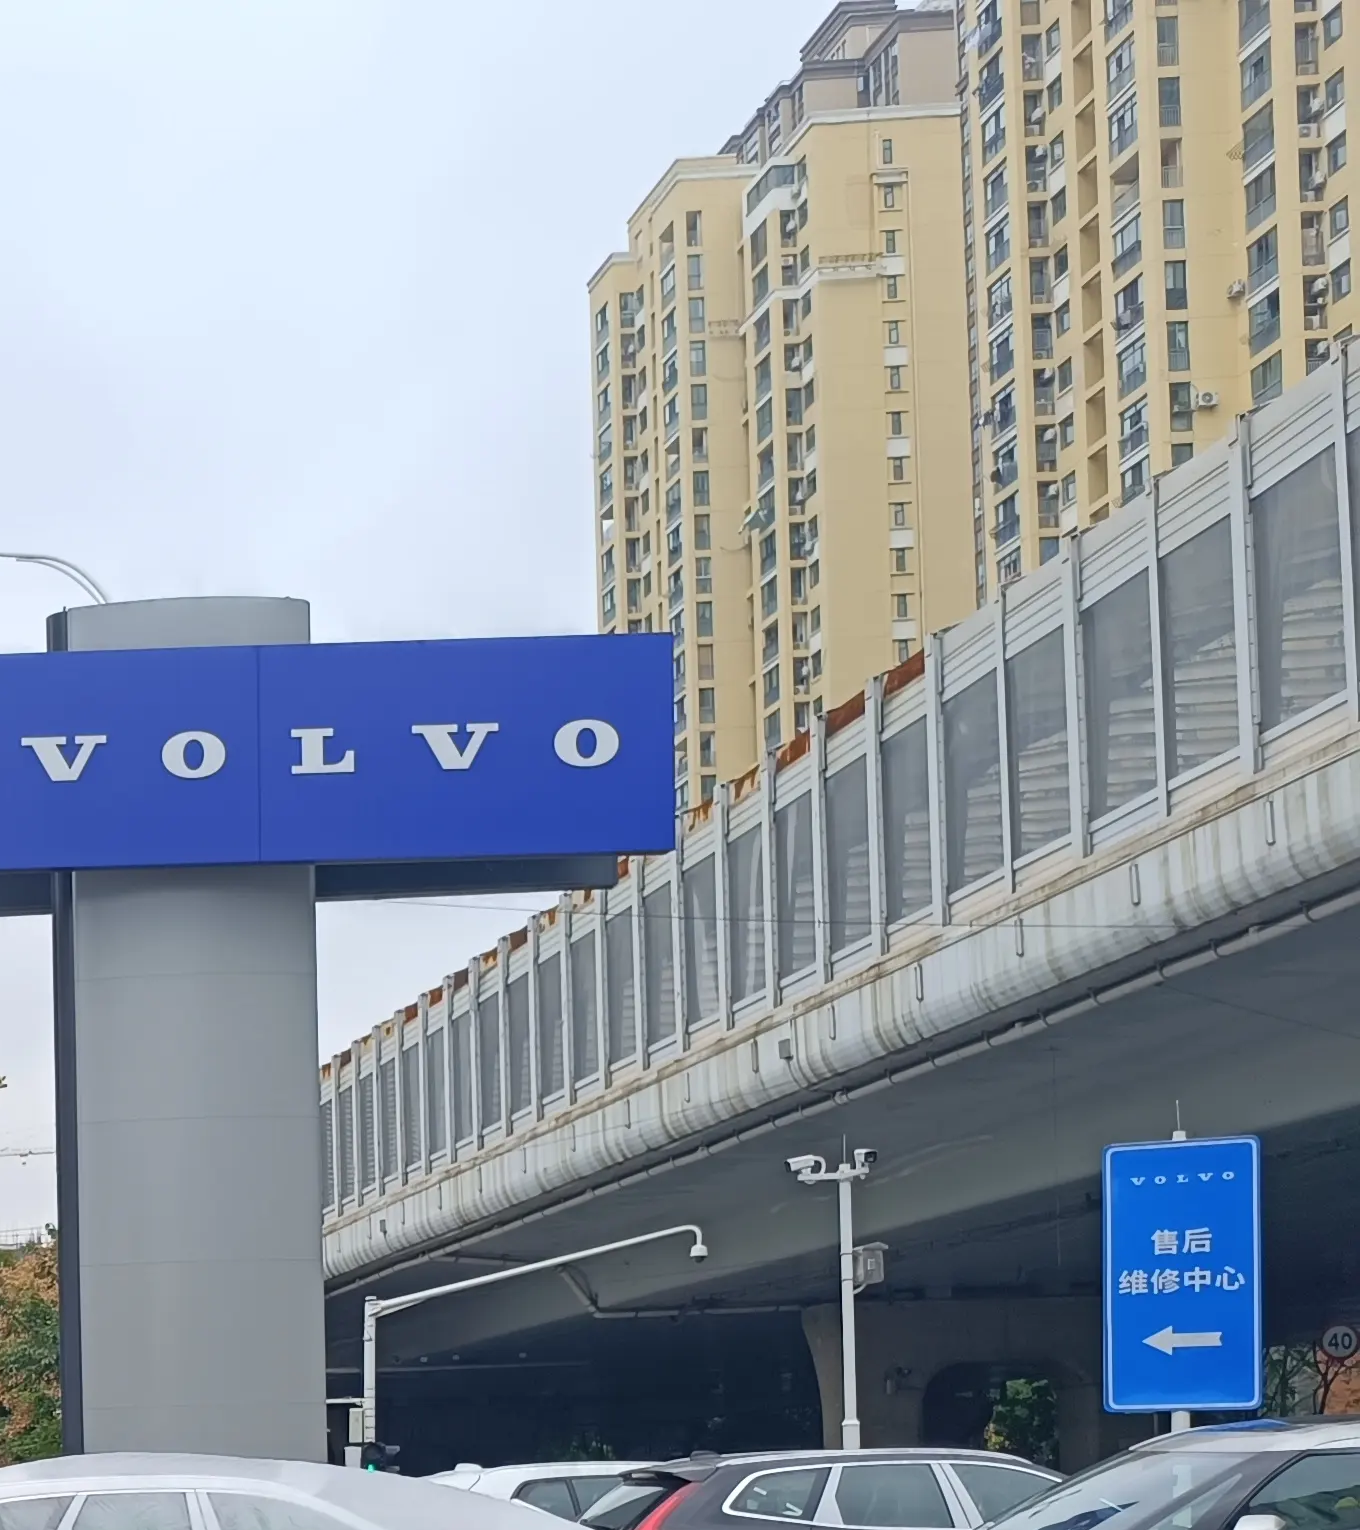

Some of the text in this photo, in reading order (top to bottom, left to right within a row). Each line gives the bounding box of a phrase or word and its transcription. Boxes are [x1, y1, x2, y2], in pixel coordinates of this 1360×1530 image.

[21, 718, 620, 782] VOLVO
[1130, 1171, 1234, 1186] VOLVO
[1151, 1227, 1212, 1256] 售后
[1118, 1265, 1245, 1295] 维修中心
[1328, 1333, 1352, 1350] 40
